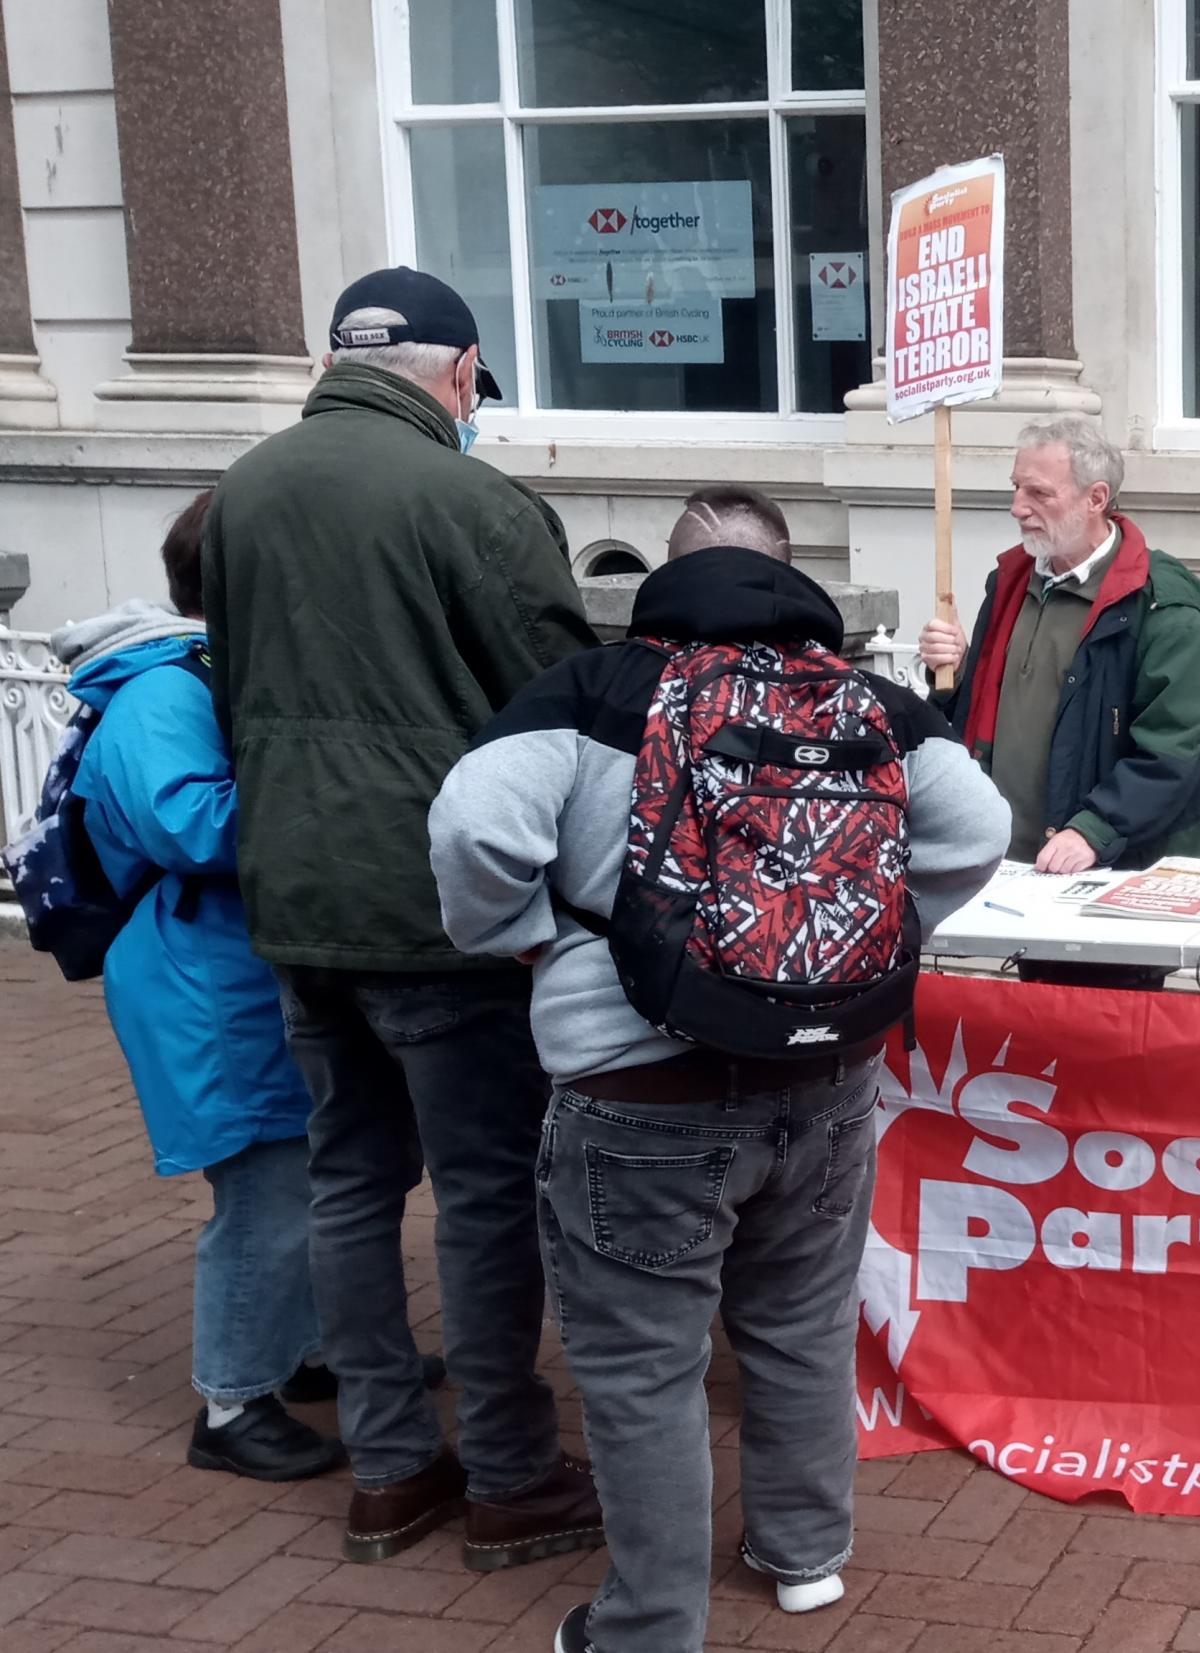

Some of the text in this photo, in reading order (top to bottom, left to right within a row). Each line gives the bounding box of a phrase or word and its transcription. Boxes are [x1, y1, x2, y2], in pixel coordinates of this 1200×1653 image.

[918, 225, 965, 270] END
[899, 253, 987, 312] ISRAELI
[607, 330, 643, 339] BRITISH
[905, 292, 976, 344] STATE
[607, 339, 643, 348] CYCLING
[676, 334, 698, 343] HSBC
[895, 327, 990, 383] TERROR
[895, 367, 991, 401] socialistparty.org.uk
